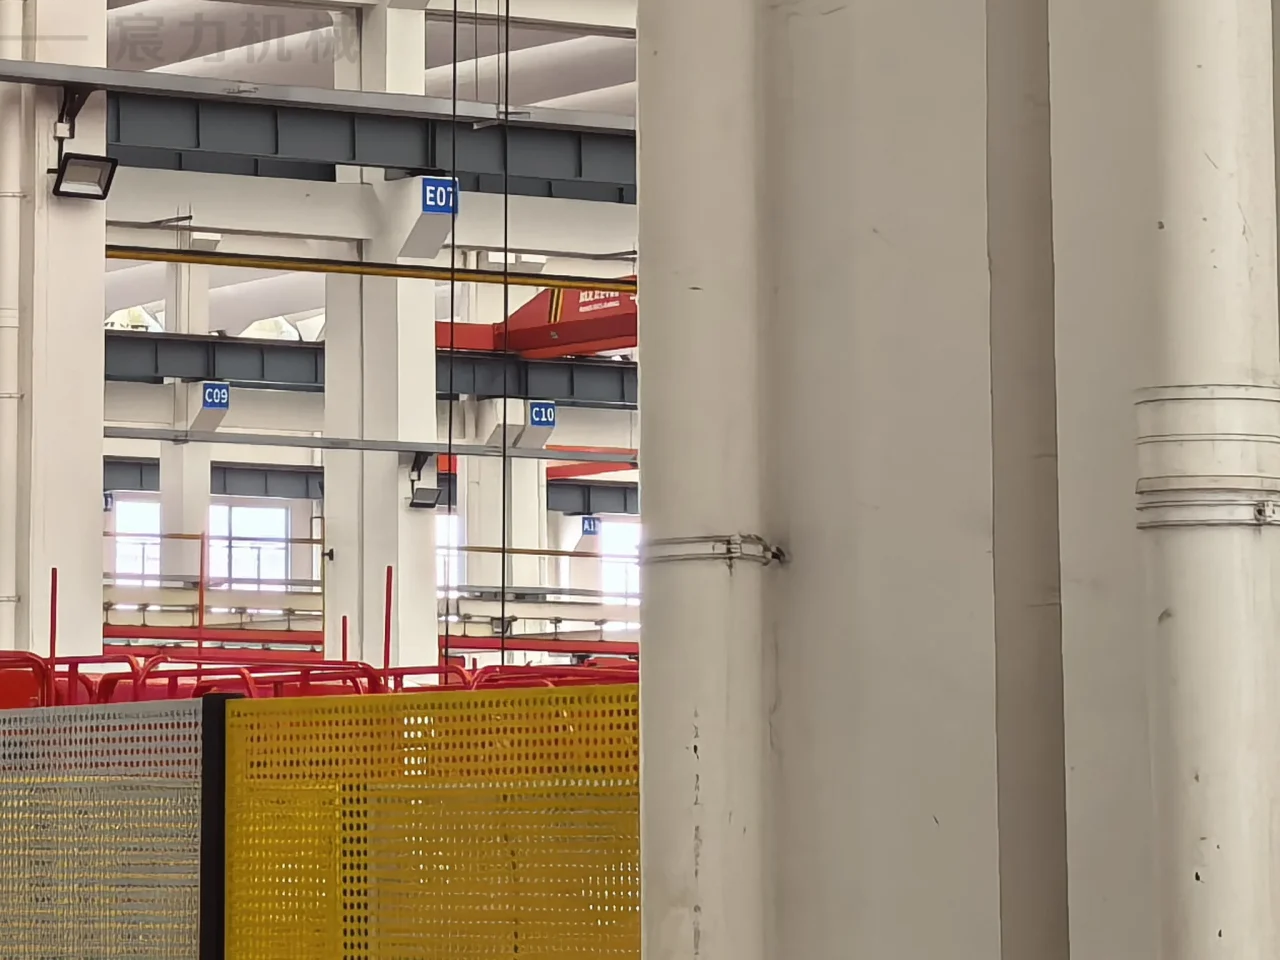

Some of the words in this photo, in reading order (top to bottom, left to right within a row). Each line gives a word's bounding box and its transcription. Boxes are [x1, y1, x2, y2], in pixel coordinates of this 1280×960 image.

[426, 185, 456, 207] E07
[205, 388, 228, 403] C09
[532, 407, 555, 422] C10
